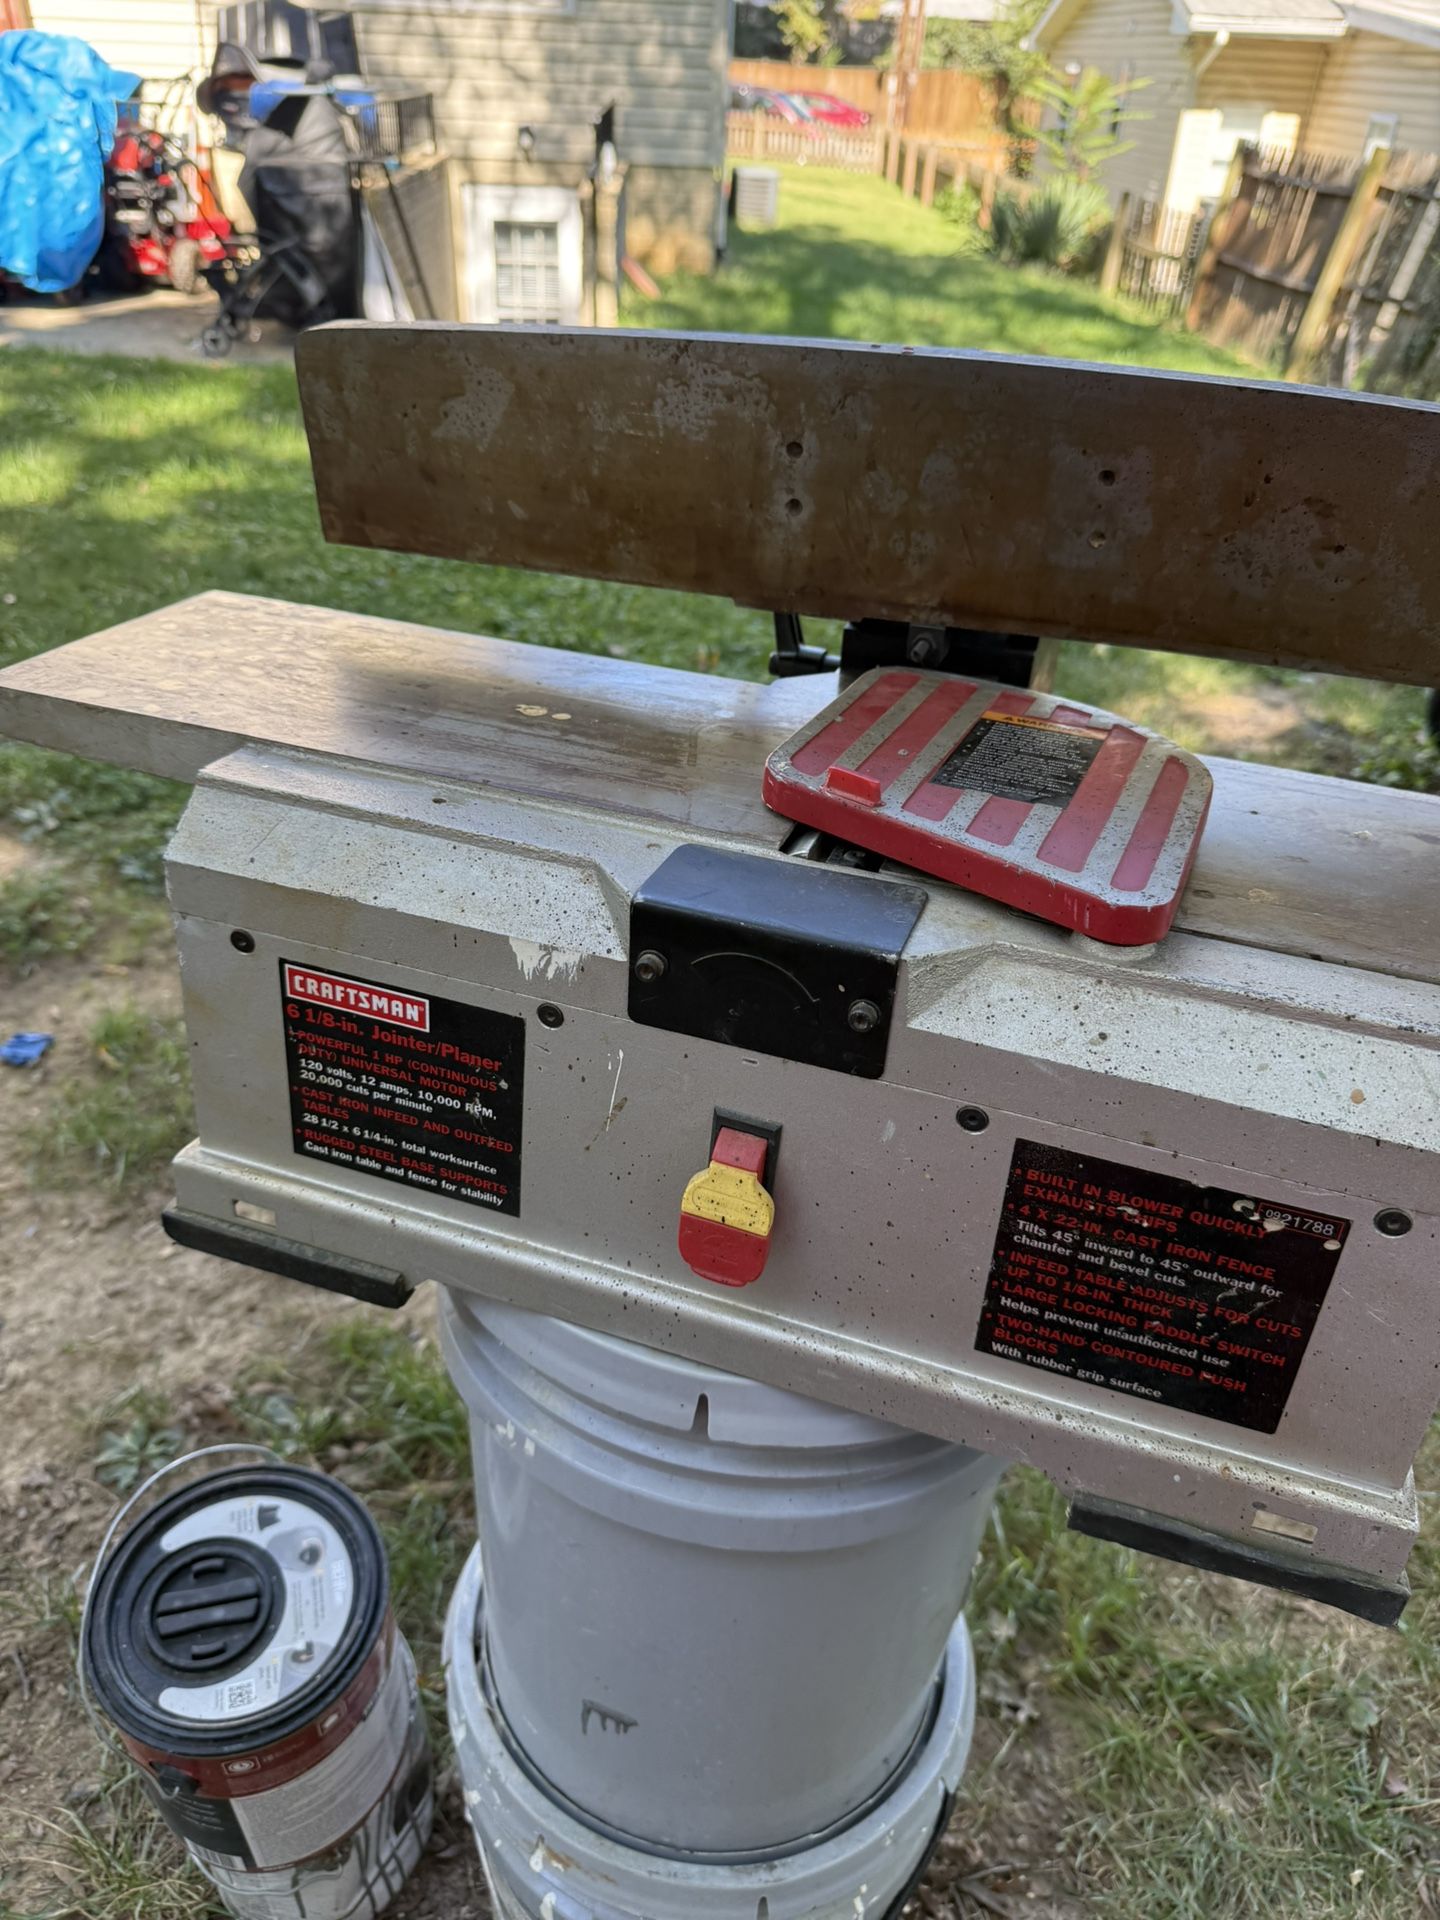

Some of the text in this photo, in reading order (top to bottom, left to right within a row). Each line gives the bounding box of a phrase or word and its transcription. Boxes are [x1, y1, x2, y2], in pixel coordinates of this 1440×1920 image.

[294, 976, 418, 1021] CRAFTSMAN
[287, 1004, 502, 1071] 6 1/8-in. Jointer/Planer
[297, 1031, 367, 1056] POWERFUL
[384, 1054, 402, 1064] HP
[408, 1060, 496, 1091] (CONTINUOUS
[298, 1044, 466, 1096] DUTY) UNIVERSAL MOTOR
[300, 1059, 322, 1071] 120
[327, 1067, 356, 1081] volts,
[362, 1075, 376, 1086] 12
[380, 1082, 412, 1096] amps,
[418, 1090, 460, 1108] 10,000
[300, 1070, 432, 1112] 20,000 cuts per minute
[302, 1087, 512, 1152] CAST IRON INFEED AND OUTFEED
[304, 1099, 349, 1119] TABLES
[304, 1113, 318, 1124] 28
[322, 1118, 338, 1129] 1/2
[353, 1127, 360, 1136] 6
[402, 1141, 425, 1154] total
[430, 1150, 496, 1174] worksurface
[304, 1130, 507, 1194] RUGGED STEEL BASE SUPPORTS
[305, 1141, 502, 1206] Cast iron table and fence for stability
[1024, 1184, 1117, 1216] EXHAUSTS
[1027, 1169, 1268, 1238] BUILT IN BLOWER QUICKLY
[1014, 1235, 1185, 1286] chamfer and bevel cuts
[1017, 1220, 1046, 1236] Tilts
[1085, 1238, 1134, 1259] inward
[1140, 1253, 1154, 1264] to
[1194, 1270, 1255, 1291] outward
[1261, 1284, 1282, 1297] for
[1020, 1205, 1275, 1281] 4 X 22-IN. CAST IRON FENCE
[1008, 1265, 1172, 1318] UP TO 1/8-IN. THICK
[1010, 1252, 1301, 1337] INFEED TABLE ADJUSTS FOR CUTS
[994, 1328, 1057, 1353] BLOCKS
[1000, 1296, 1230, 1367] Helps prevent unauthorized use
[1002, 1280, 1285, 1366] LARGE LOCKING PADDLE SWITCH
[992, 1342, 1161, 1397] With rubber grip surface
[1091, 1341, 1193, 1376] CONTOURED
[1199, 1371, 1246, 1392] PUSH
